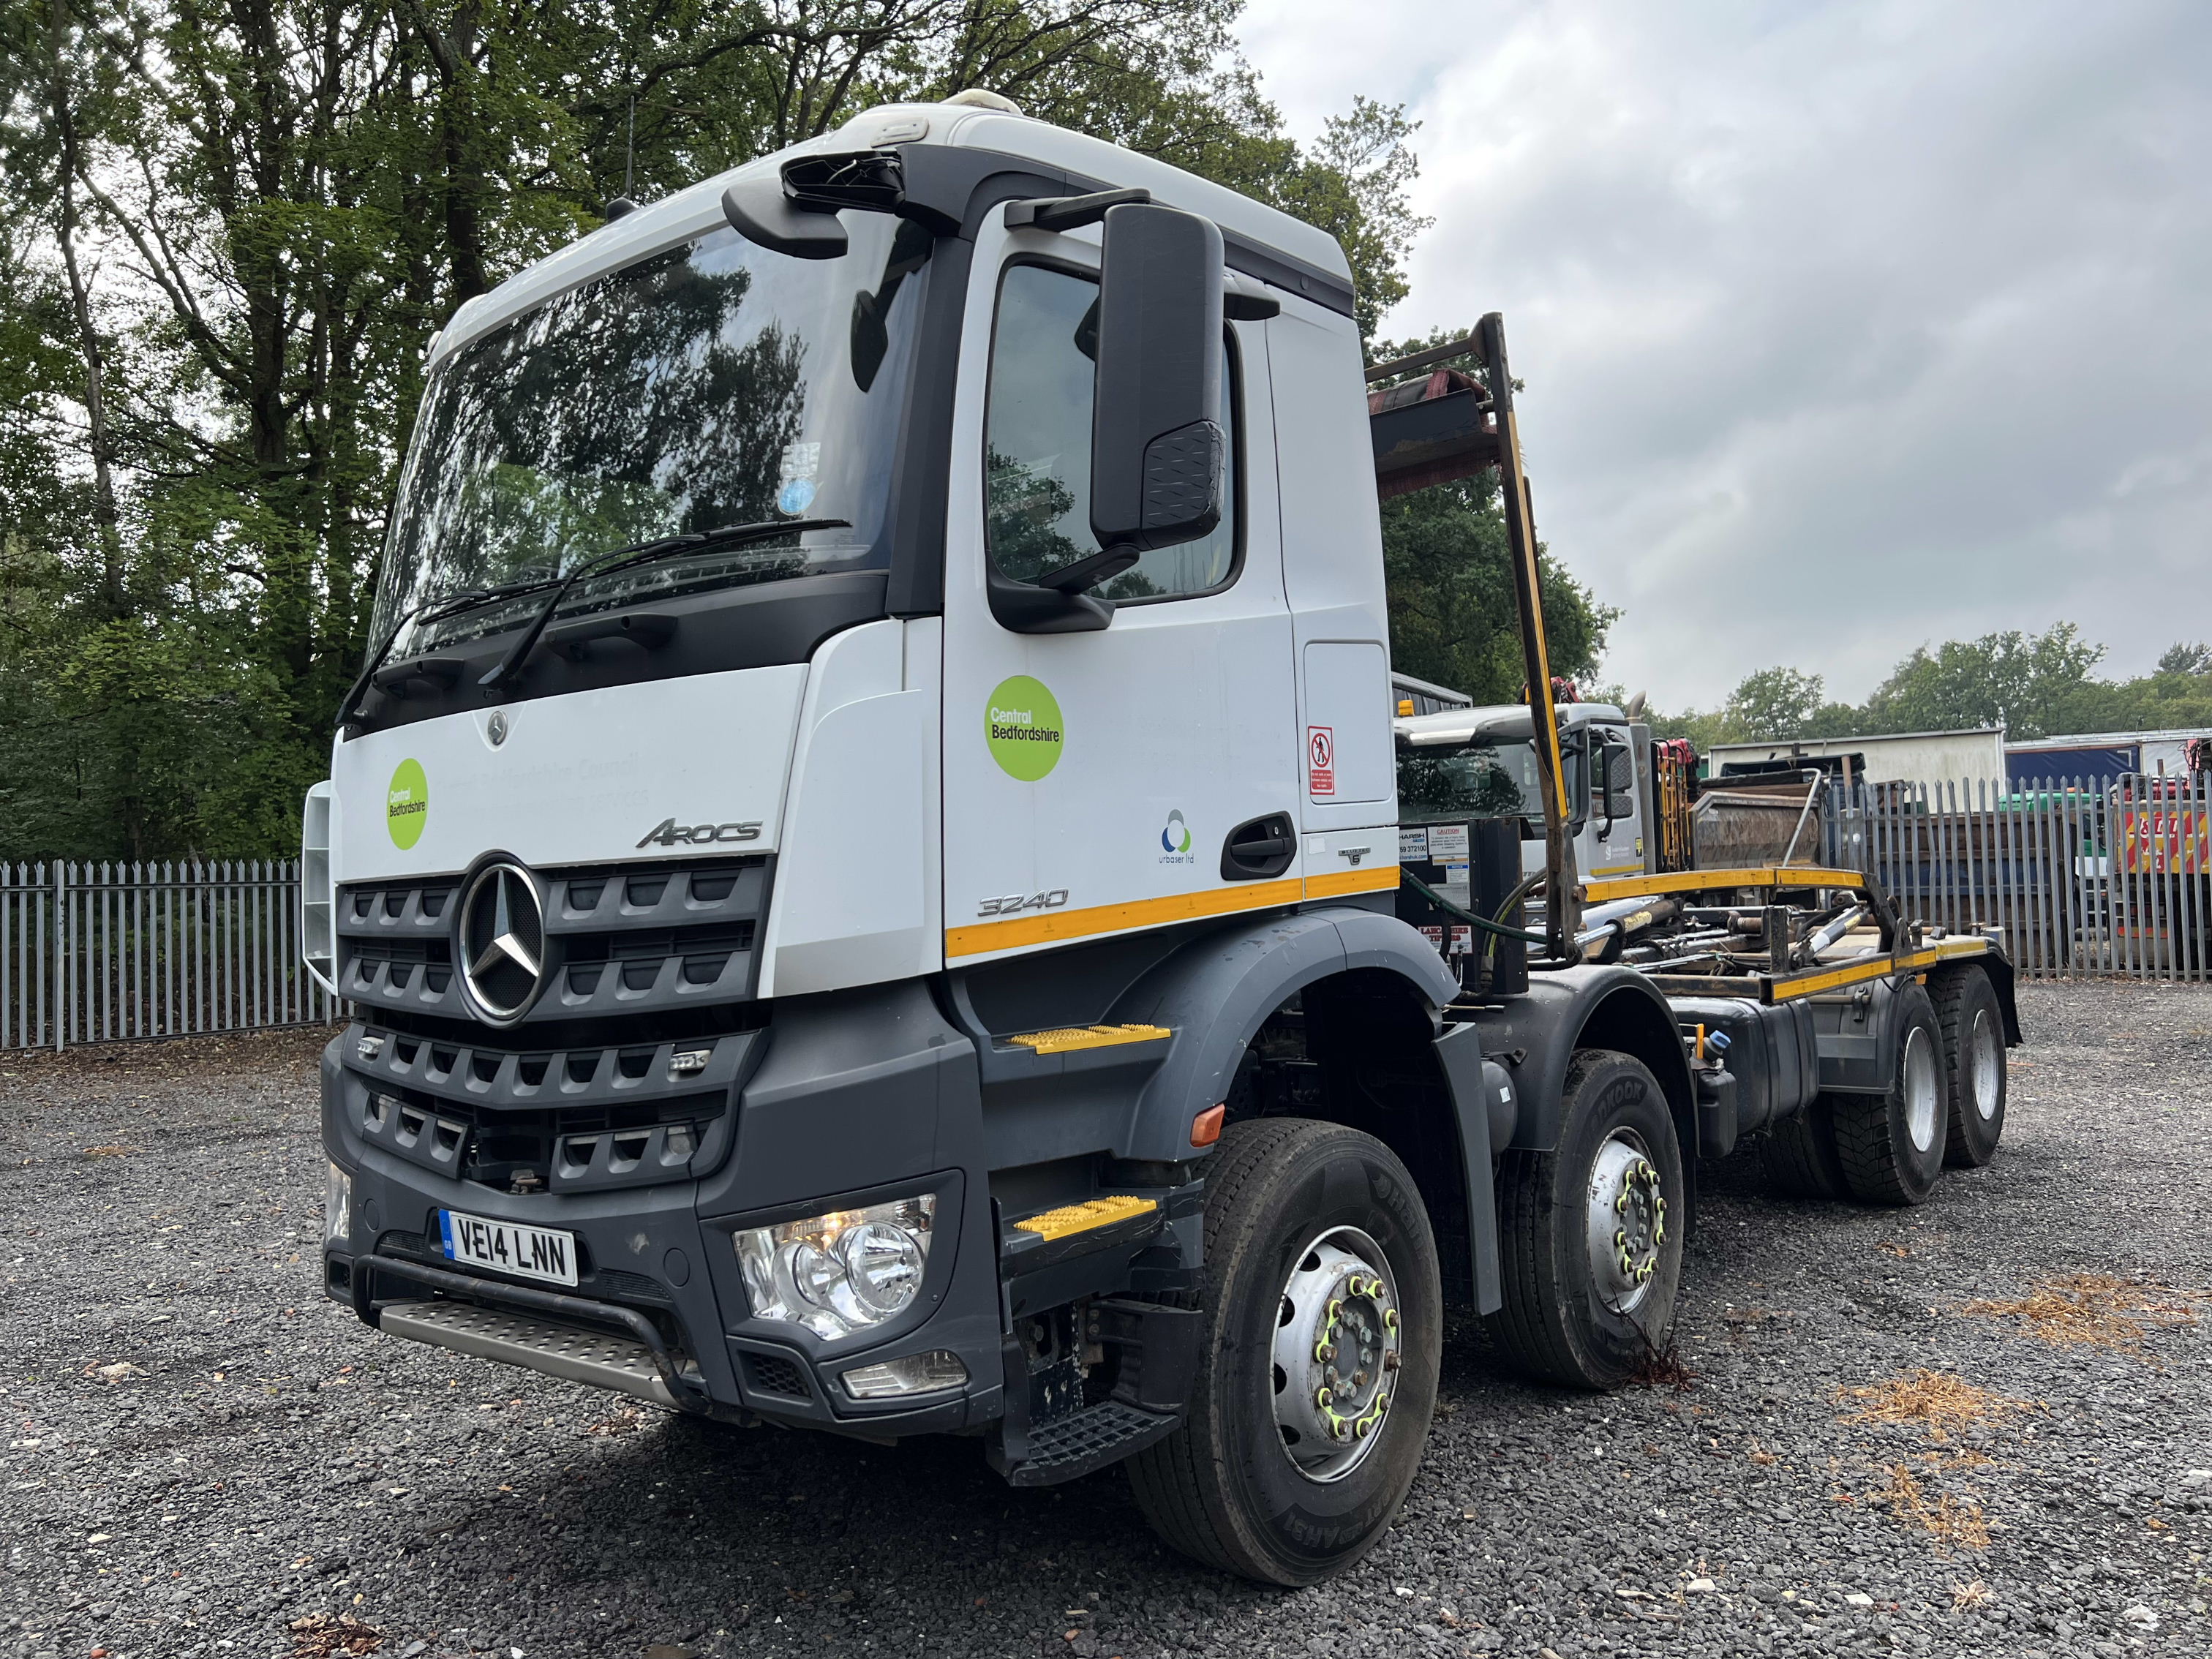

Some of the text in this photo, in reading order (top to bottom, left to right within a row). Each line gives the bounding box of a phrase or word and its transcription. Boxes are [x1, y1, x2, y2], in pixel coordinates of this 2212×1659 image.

[990, 707, 1032, 724] Central
[992, 723, 1059, 742] Bedfordshire
[390, 786, 411, 803] Central
[389, 800, 426, 817] Bedfordshire
[1159, 852, 1194, 864] urbaser ltd
[1353, 854, 1360, 863] 6
[978, 887, 1069, 917] 3240
[444, 1239, 452, 1250] GB
[458, 1219, 566, 1276] VE14 LNN
